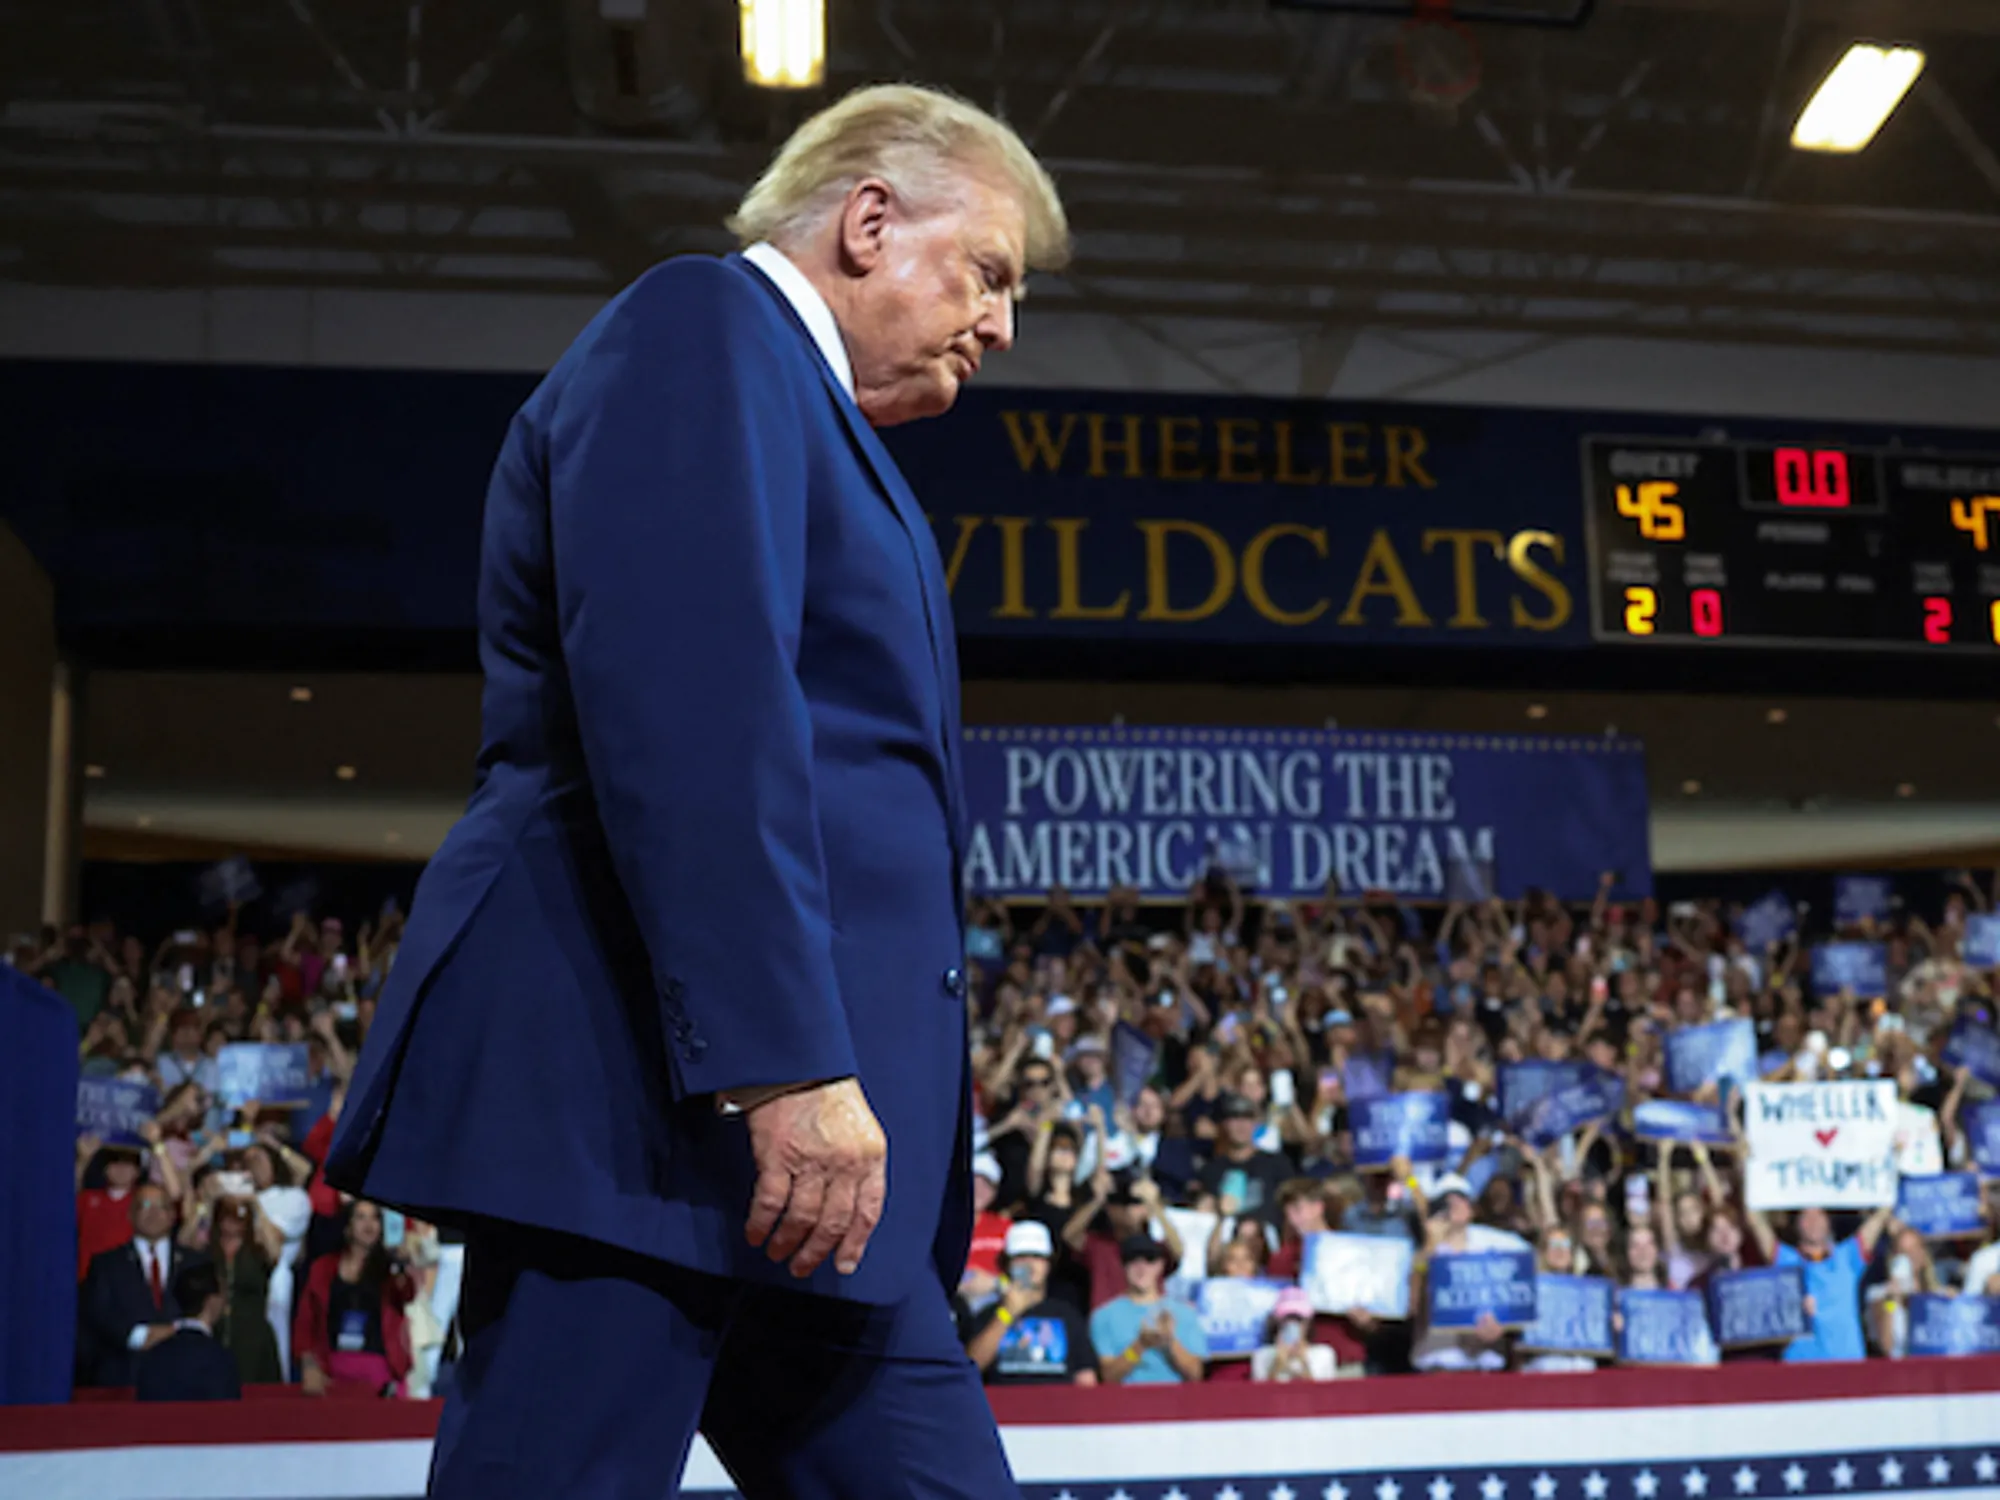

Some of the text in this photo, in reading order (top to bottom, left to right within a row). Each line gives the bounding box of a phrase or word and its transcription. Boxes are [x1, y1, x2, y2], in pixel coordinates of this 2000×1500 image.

[1004, 411, 1438, 490] WHEELER
[1615, 481, 1686, 541] 45
[1624, 586, 1656, 636] 2
[1690, 588, 1723, 637] 0
[1923, 596, 1953, 644] 2
[1004, 747, 1456, 820] POWERING THE
